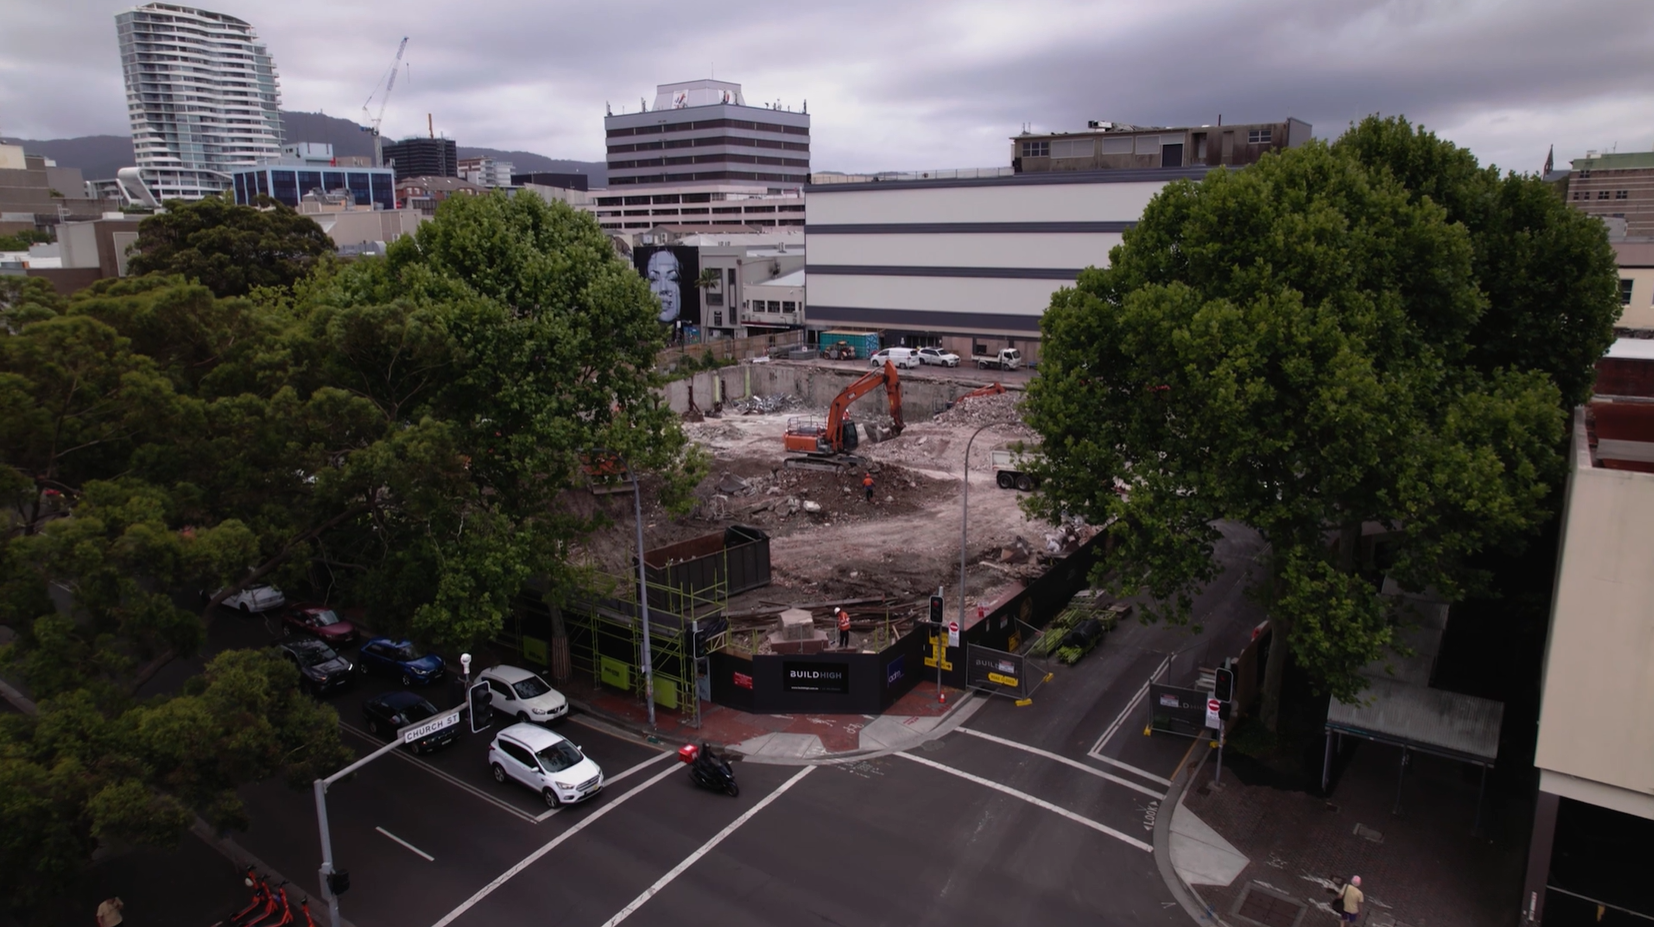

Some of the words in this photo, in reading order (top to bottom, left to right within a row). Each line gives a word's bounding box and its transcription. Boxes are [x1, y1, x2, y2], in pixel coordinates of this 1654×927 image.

[789, 669, 842, 680] BUILDHIGH
[406, 721, 443, 740] CHURCH
[447, 714, 458, 725] ST
[1143, 805, 1158, 826] LOOK
